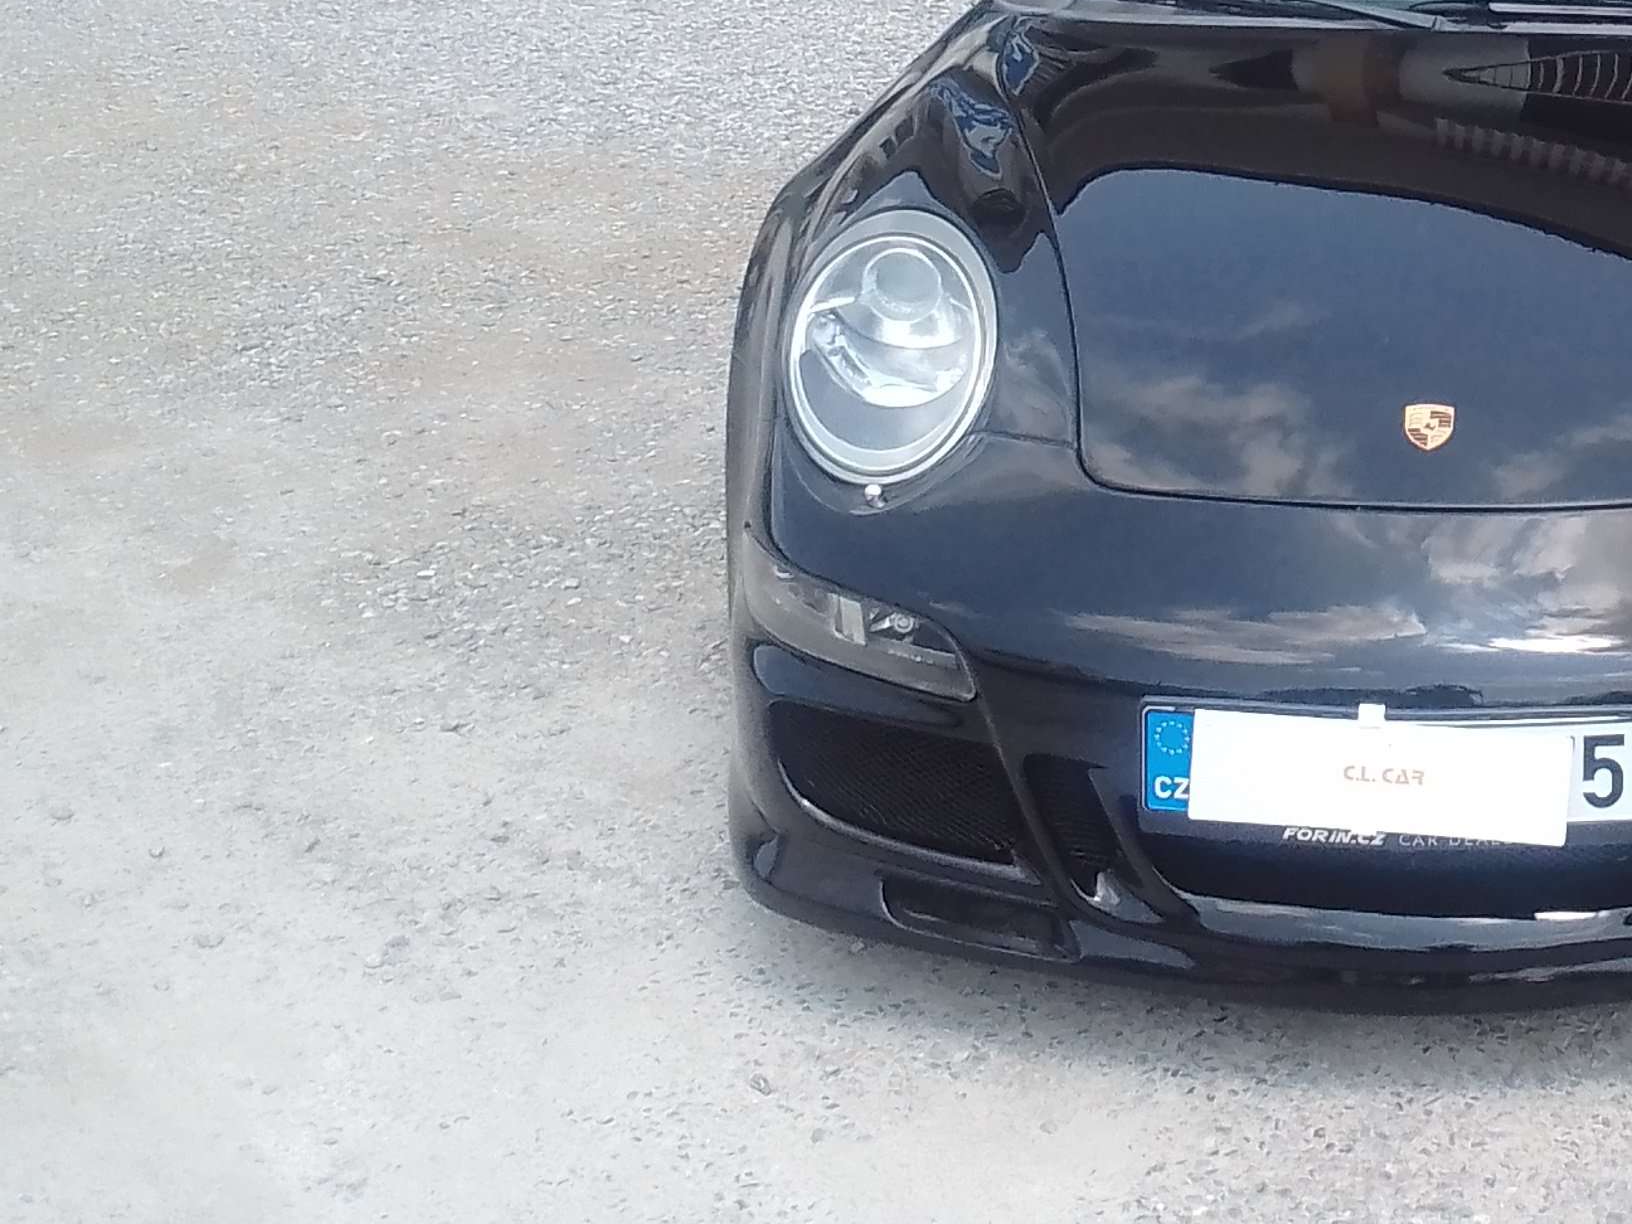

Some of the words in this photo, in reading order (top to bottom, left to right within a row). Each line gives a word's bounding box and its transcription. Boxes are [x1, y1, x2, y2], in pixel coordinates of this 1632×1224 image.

[1154, 775, 1190, 799] CZ
[1582, 733, 1625, 808] 5
[1382, 767, 1425, 786] CAR
